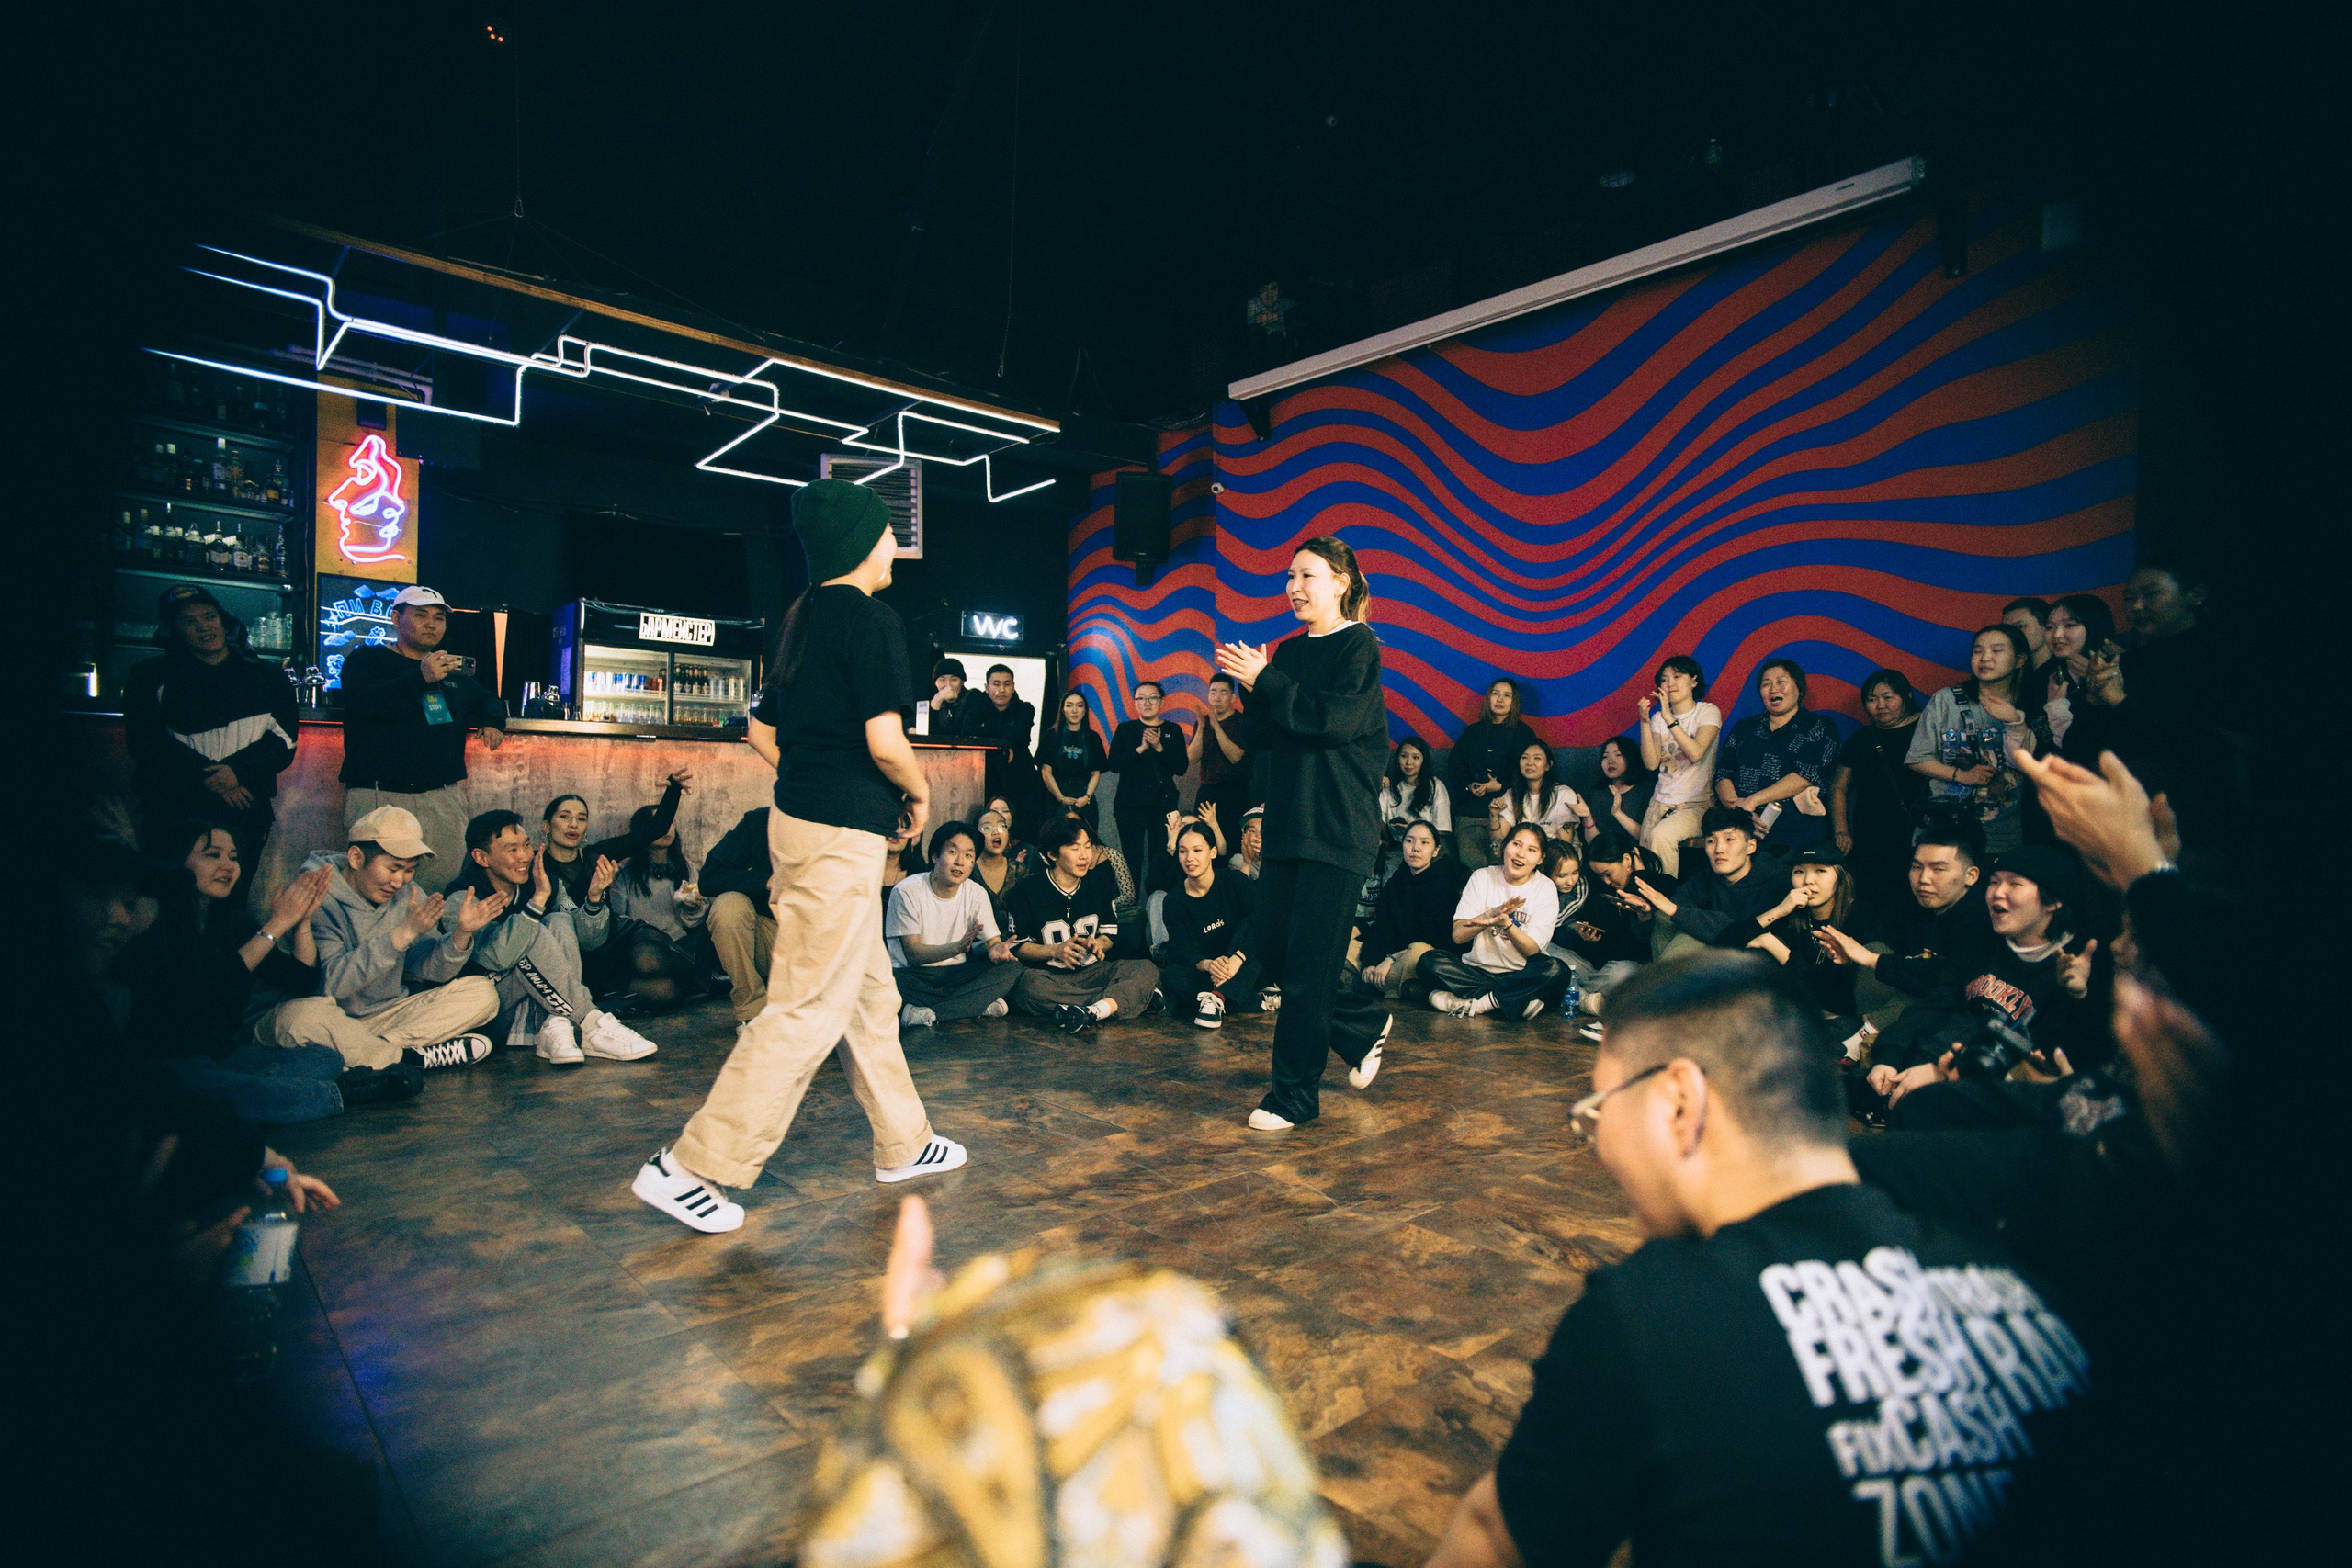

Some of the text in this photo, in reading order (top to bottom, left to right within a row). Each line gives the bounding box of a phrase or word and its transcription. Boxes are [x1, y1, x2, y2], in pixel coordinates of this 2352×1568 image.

[972, 615, 1019, 639] WC
[1786, 1309, 1990, 1408] FRESH
[1879, 1387, 2036, 1472] CASH
